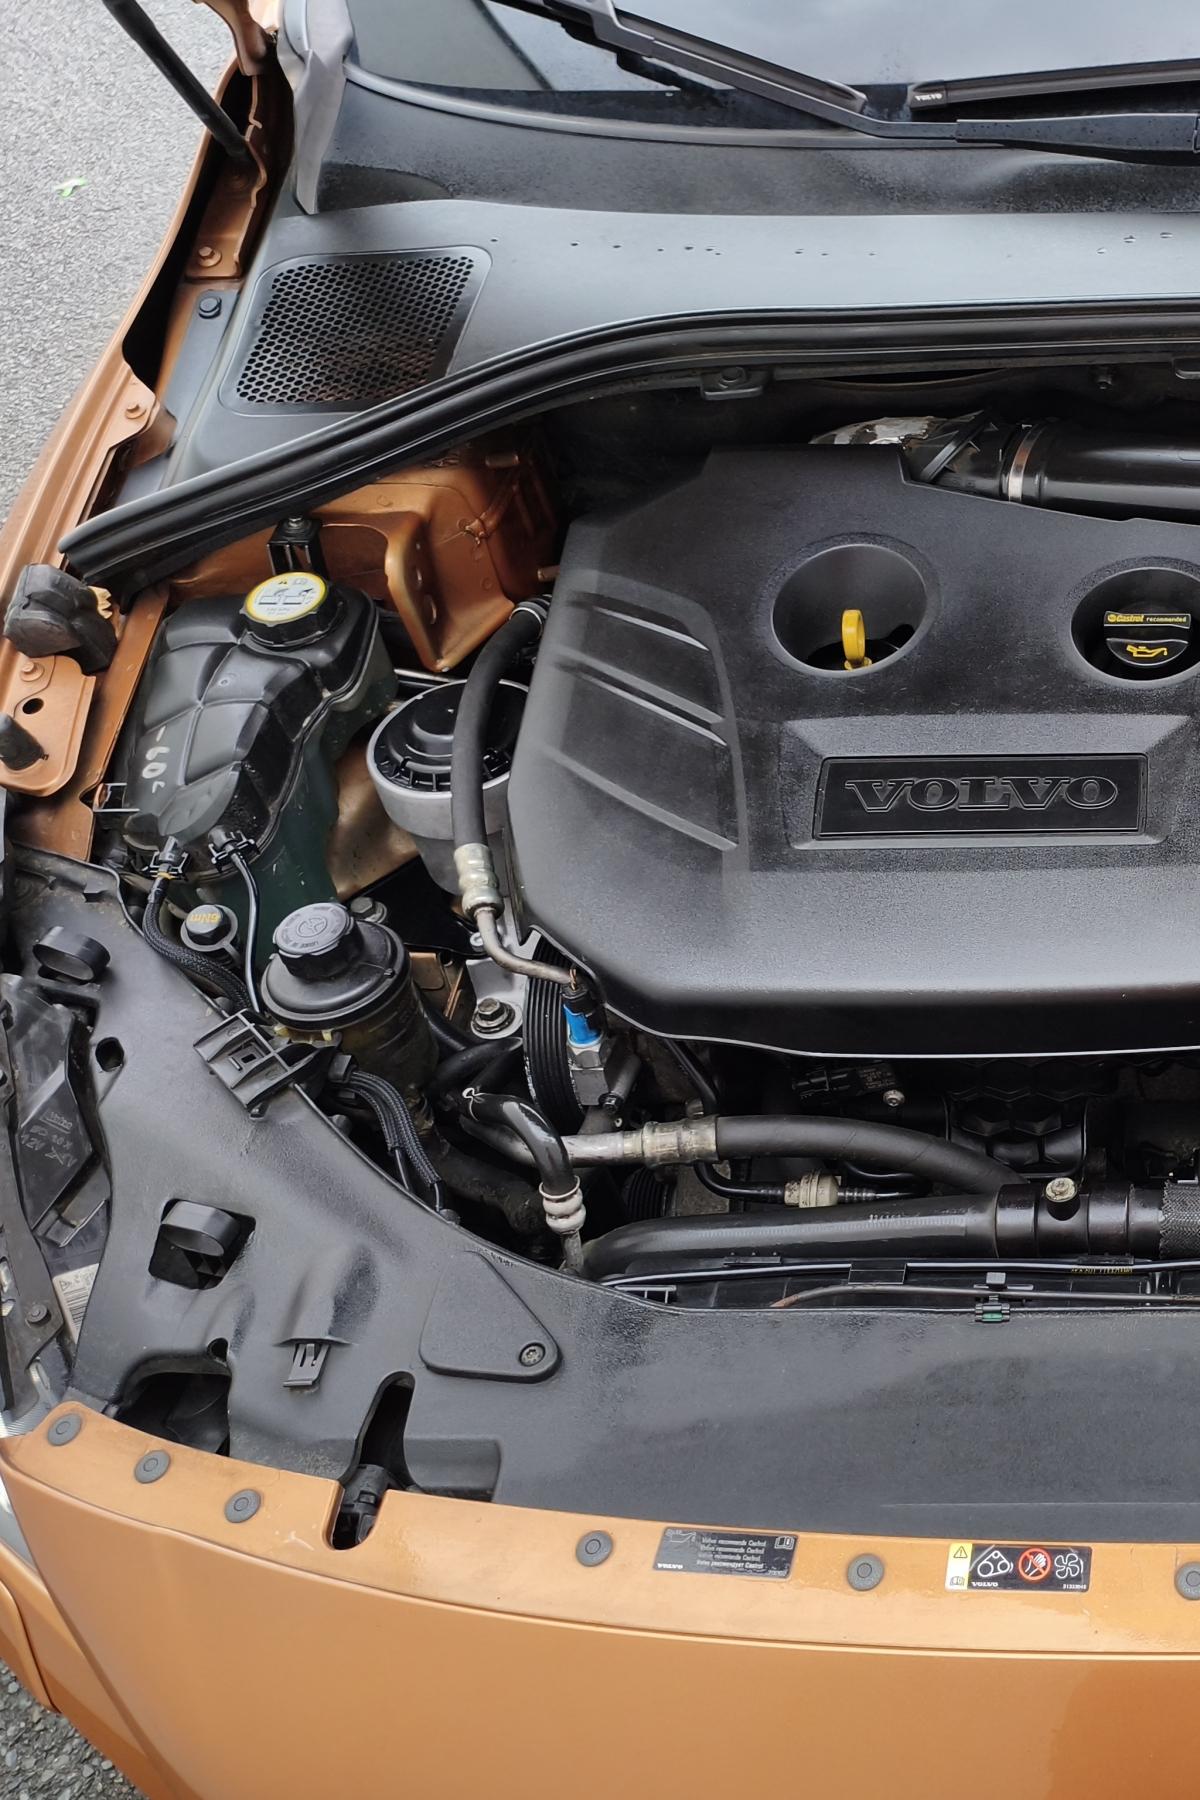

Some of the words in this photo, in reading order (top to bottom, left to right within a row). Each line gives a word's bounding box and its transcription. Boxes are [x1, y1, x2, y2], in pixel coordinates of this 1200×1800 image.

[914, 93, 943, 101] VOLVO
[1117, 614, 1144, 622] Castrol
[845, 776, 1118, 813] VOLVO
